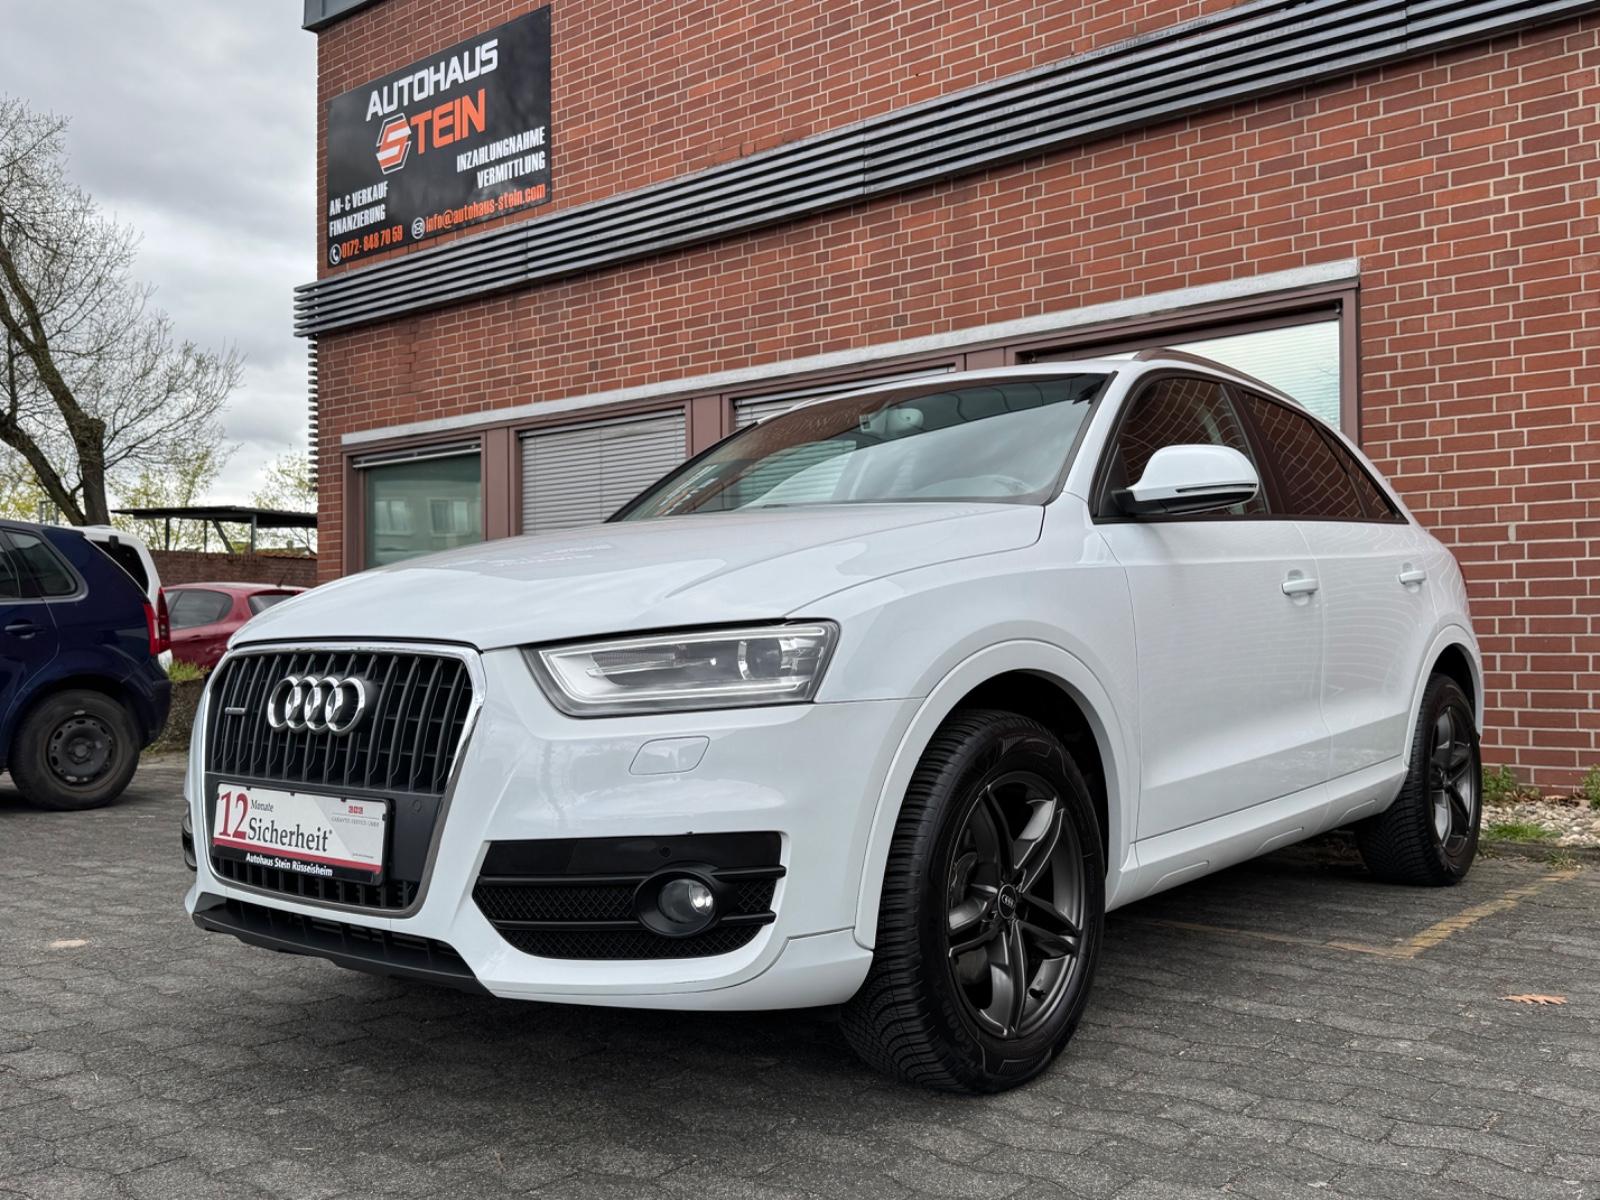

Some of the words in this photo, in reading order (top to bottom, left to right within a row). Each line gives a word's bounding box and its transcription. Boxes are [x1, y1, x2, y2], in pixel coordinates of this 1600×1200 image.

[366, 39, 498, 121] AUTOHAUS
[457, 126, 545, 173] INZAHLUNGNAHME
[477, 151, 545, 189] VERMITTLUNG
[352, 180, 389, 208] VERKAUF
[426, 183, 546, 232] info@autohaus-stein.com
[329, 203, 386, 238] FINANZIERUNG
[219, 791, 249, 840] 12
[251, 799, 274, 813] Monate
[246, 852, 273, 867] Autohaus
[274, 857, 291, 869] Stein
